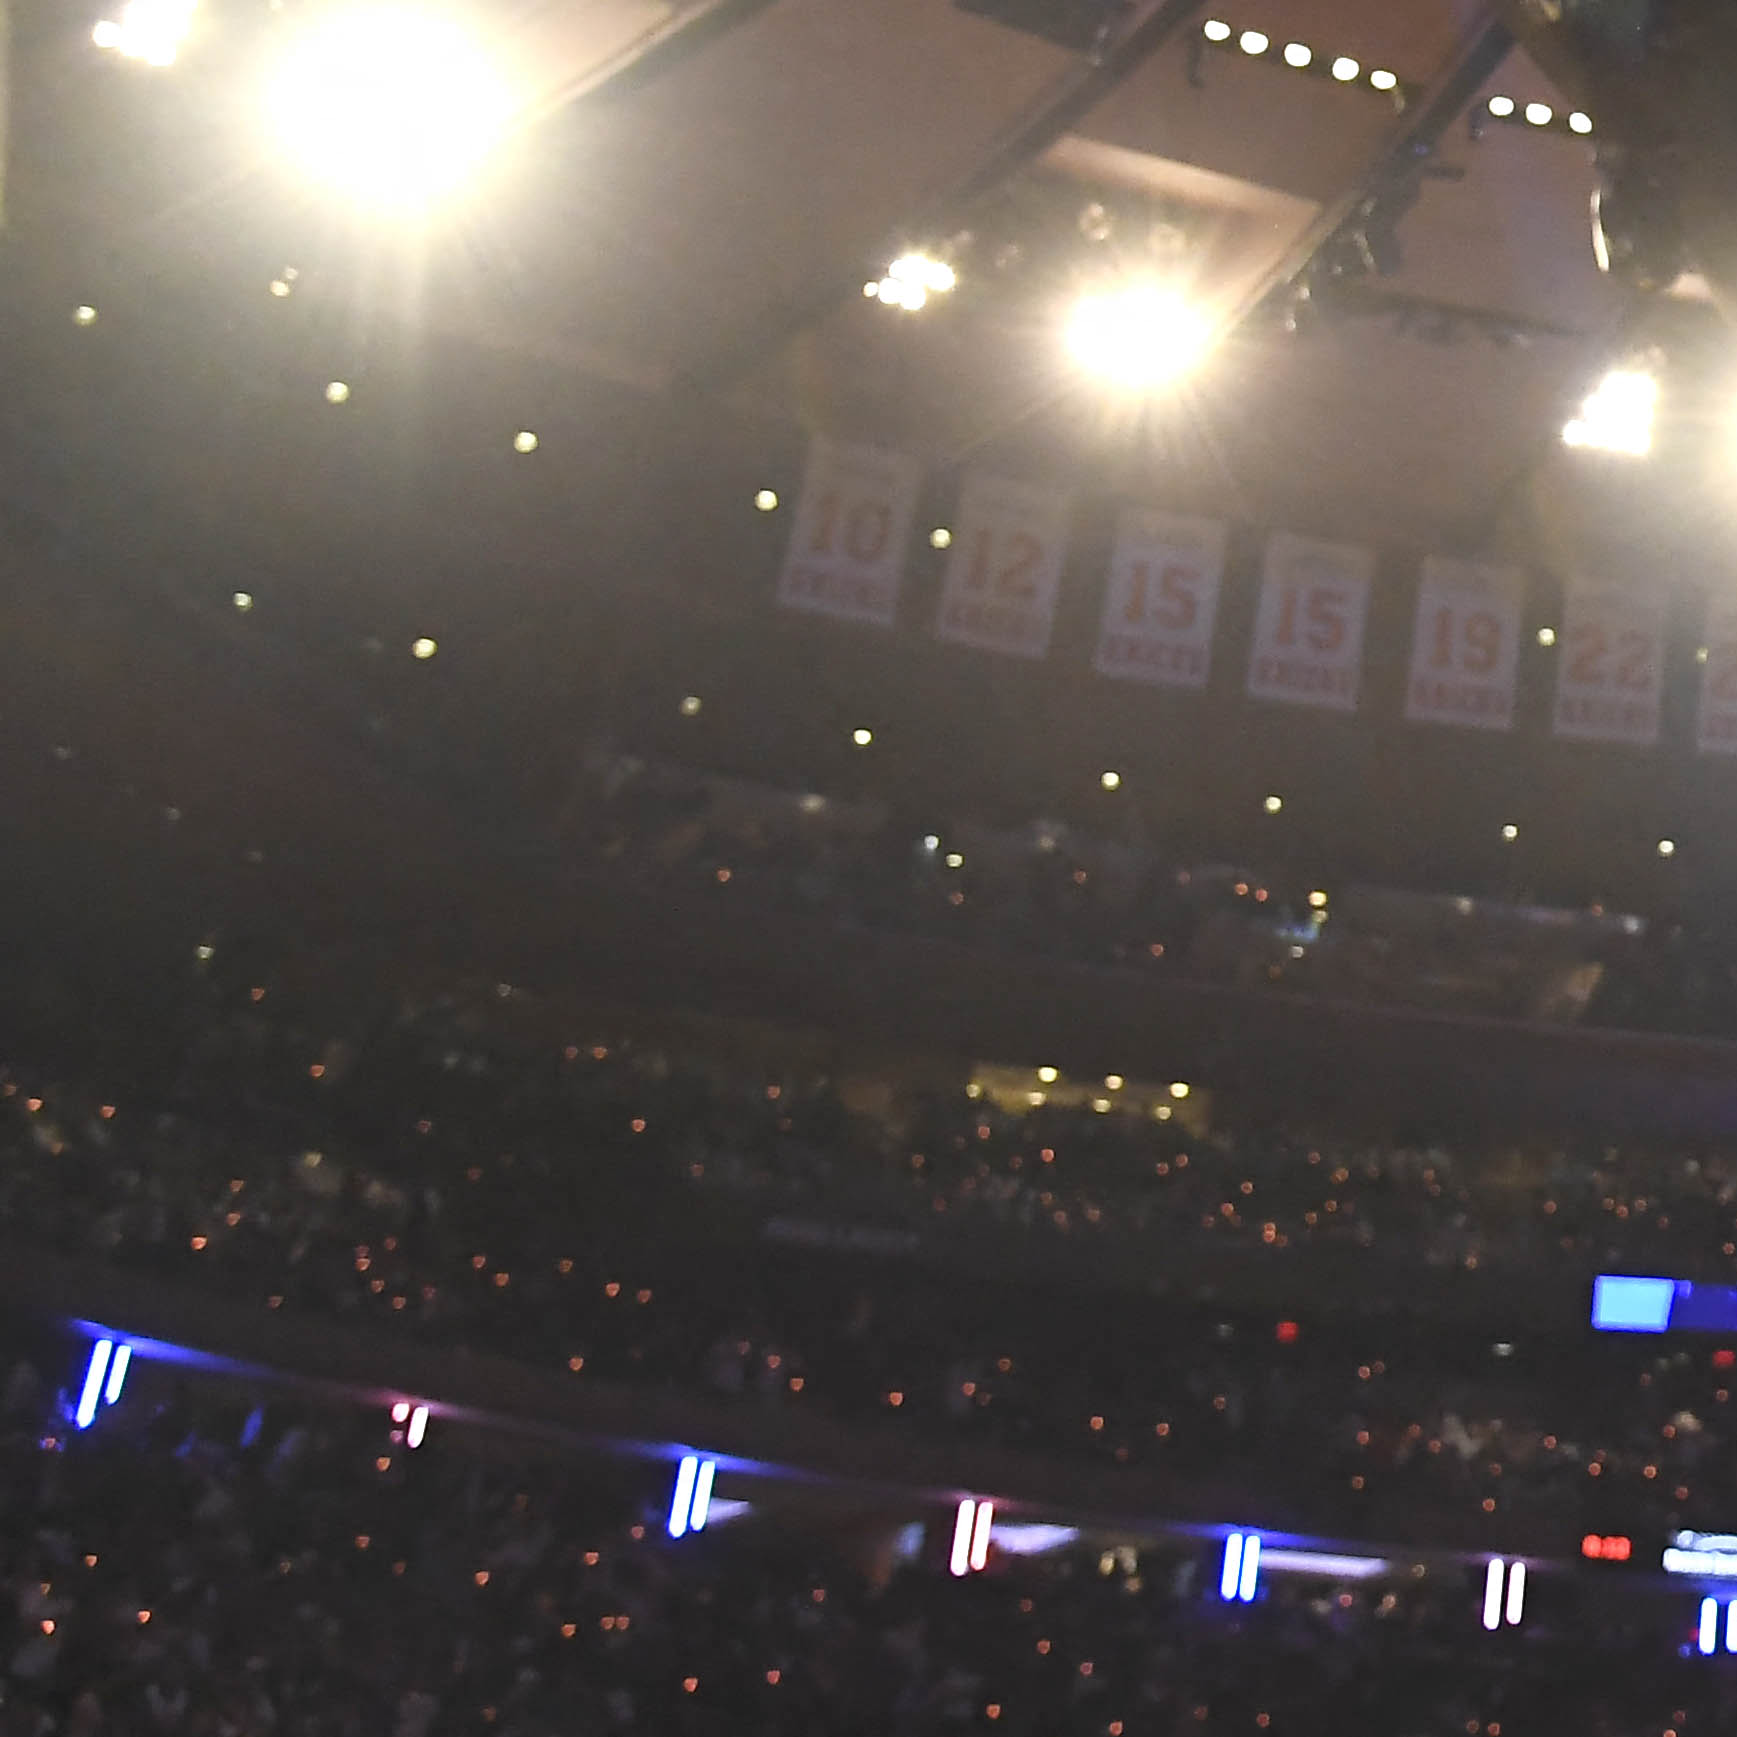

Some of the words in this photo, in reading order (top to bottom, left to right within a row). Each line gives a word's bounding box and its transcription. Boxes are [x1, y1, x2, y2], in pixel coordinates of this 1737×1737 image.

[808, 490, 892, 562] 10
[964, 526, 1044, 598] 12
[1122, 560, 1200, 632] 15
[1276, 585, 1346, 655] 15
[1432, 607, 1504, 674] 19
